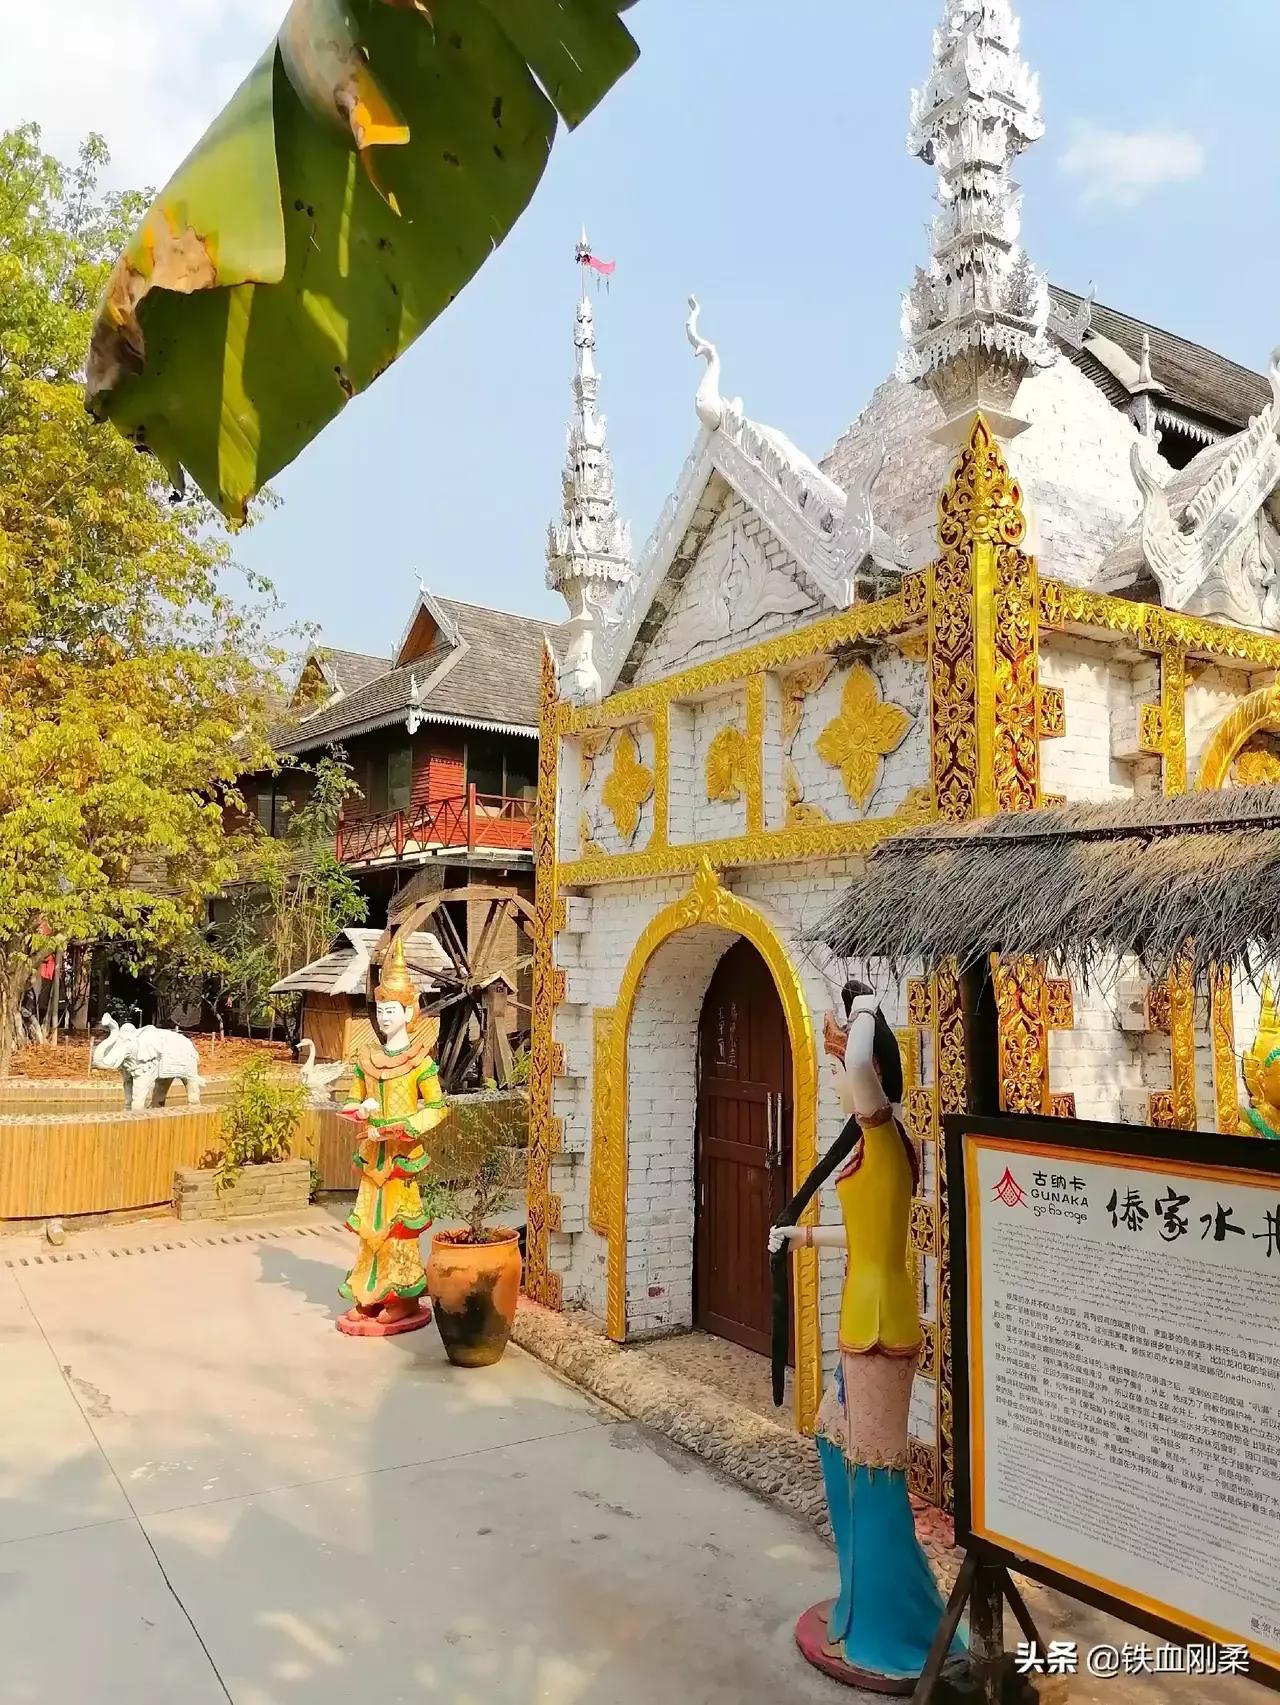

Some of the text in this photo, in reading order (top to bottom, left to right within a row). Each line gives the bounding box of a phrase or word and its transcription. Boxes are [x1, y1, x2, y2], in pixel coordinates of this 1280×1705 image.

[1032, 1170, 1086, 1192] 古纳卡
[1031, 1188, 1088, 1207] GUNAKA
